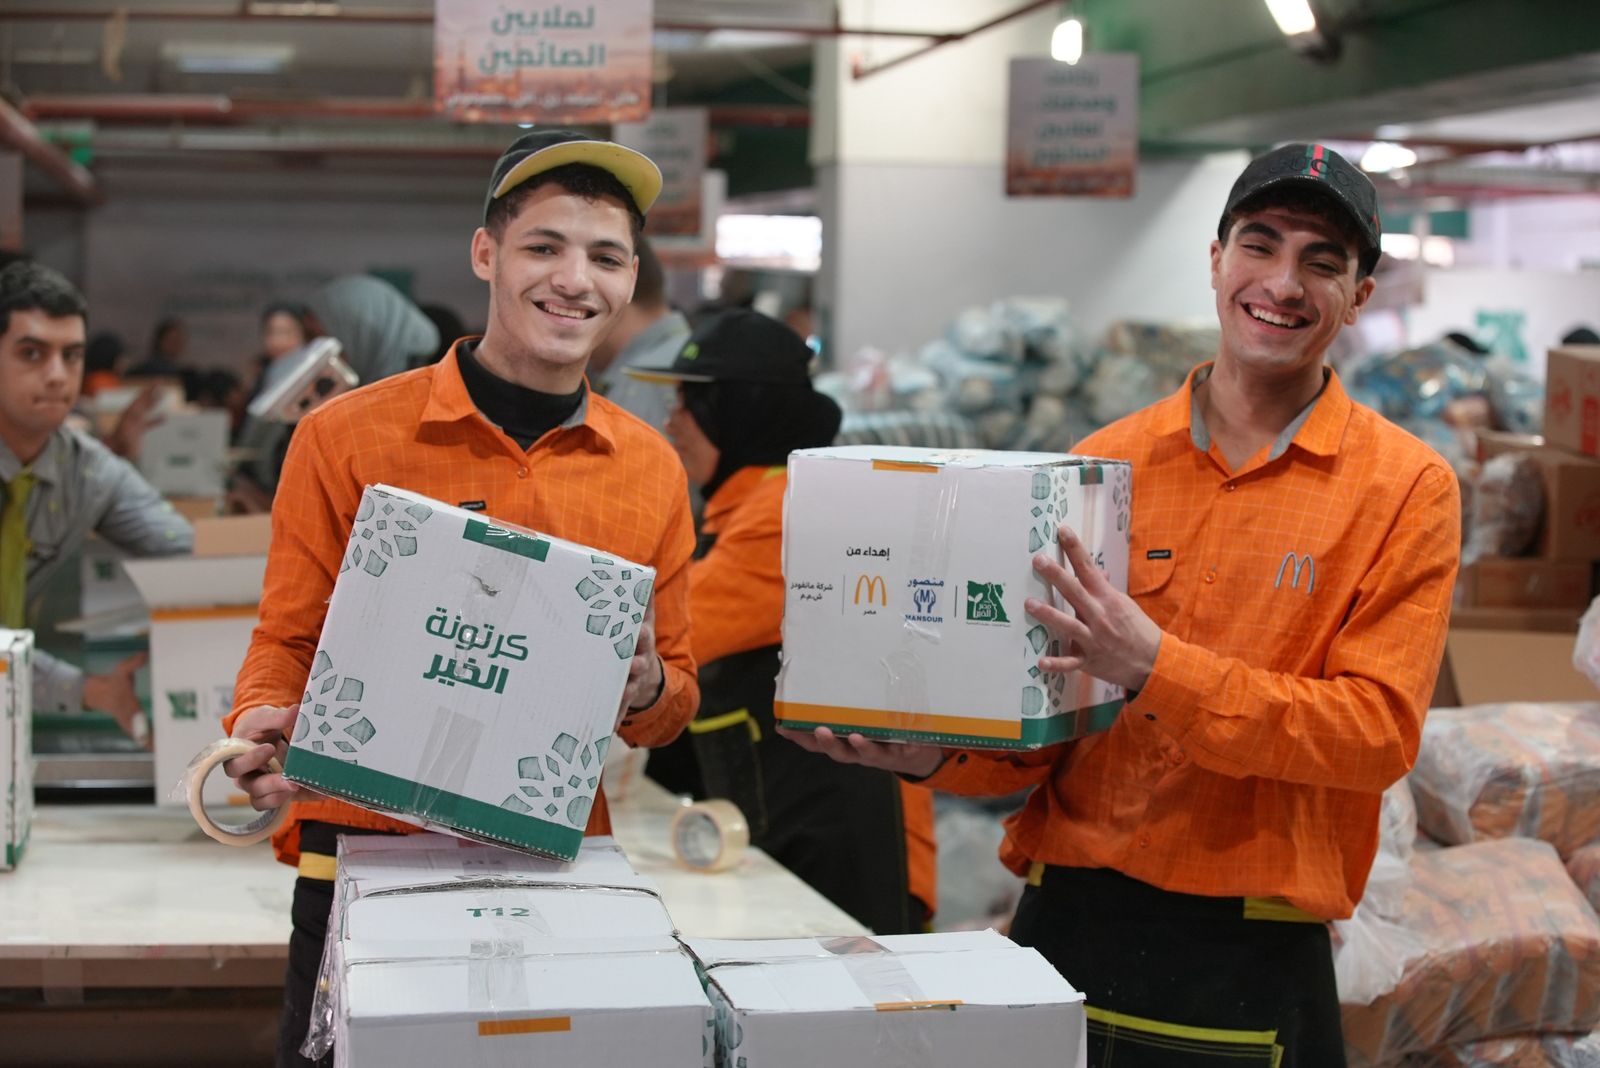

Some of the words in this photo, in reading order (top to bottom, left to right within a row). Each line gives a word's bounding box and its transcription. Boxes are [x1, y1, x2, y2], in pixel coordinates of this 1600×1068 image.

[490, 4, 595, 36] لملايين
[478, 40, 606, 75] الصائمين
[846, 546, 861, 557] من
[863, 546, 890, 561] إهداء
[816, 583, 834, 592] شركة
[907, 577, 945, 588] منصور
[905, 614, 943, 624] MANSOUR
[425, 606, 529, 662] كرتونة
[422, 653, 510, 695] الخير
[465, 907, 530, 918] T12
